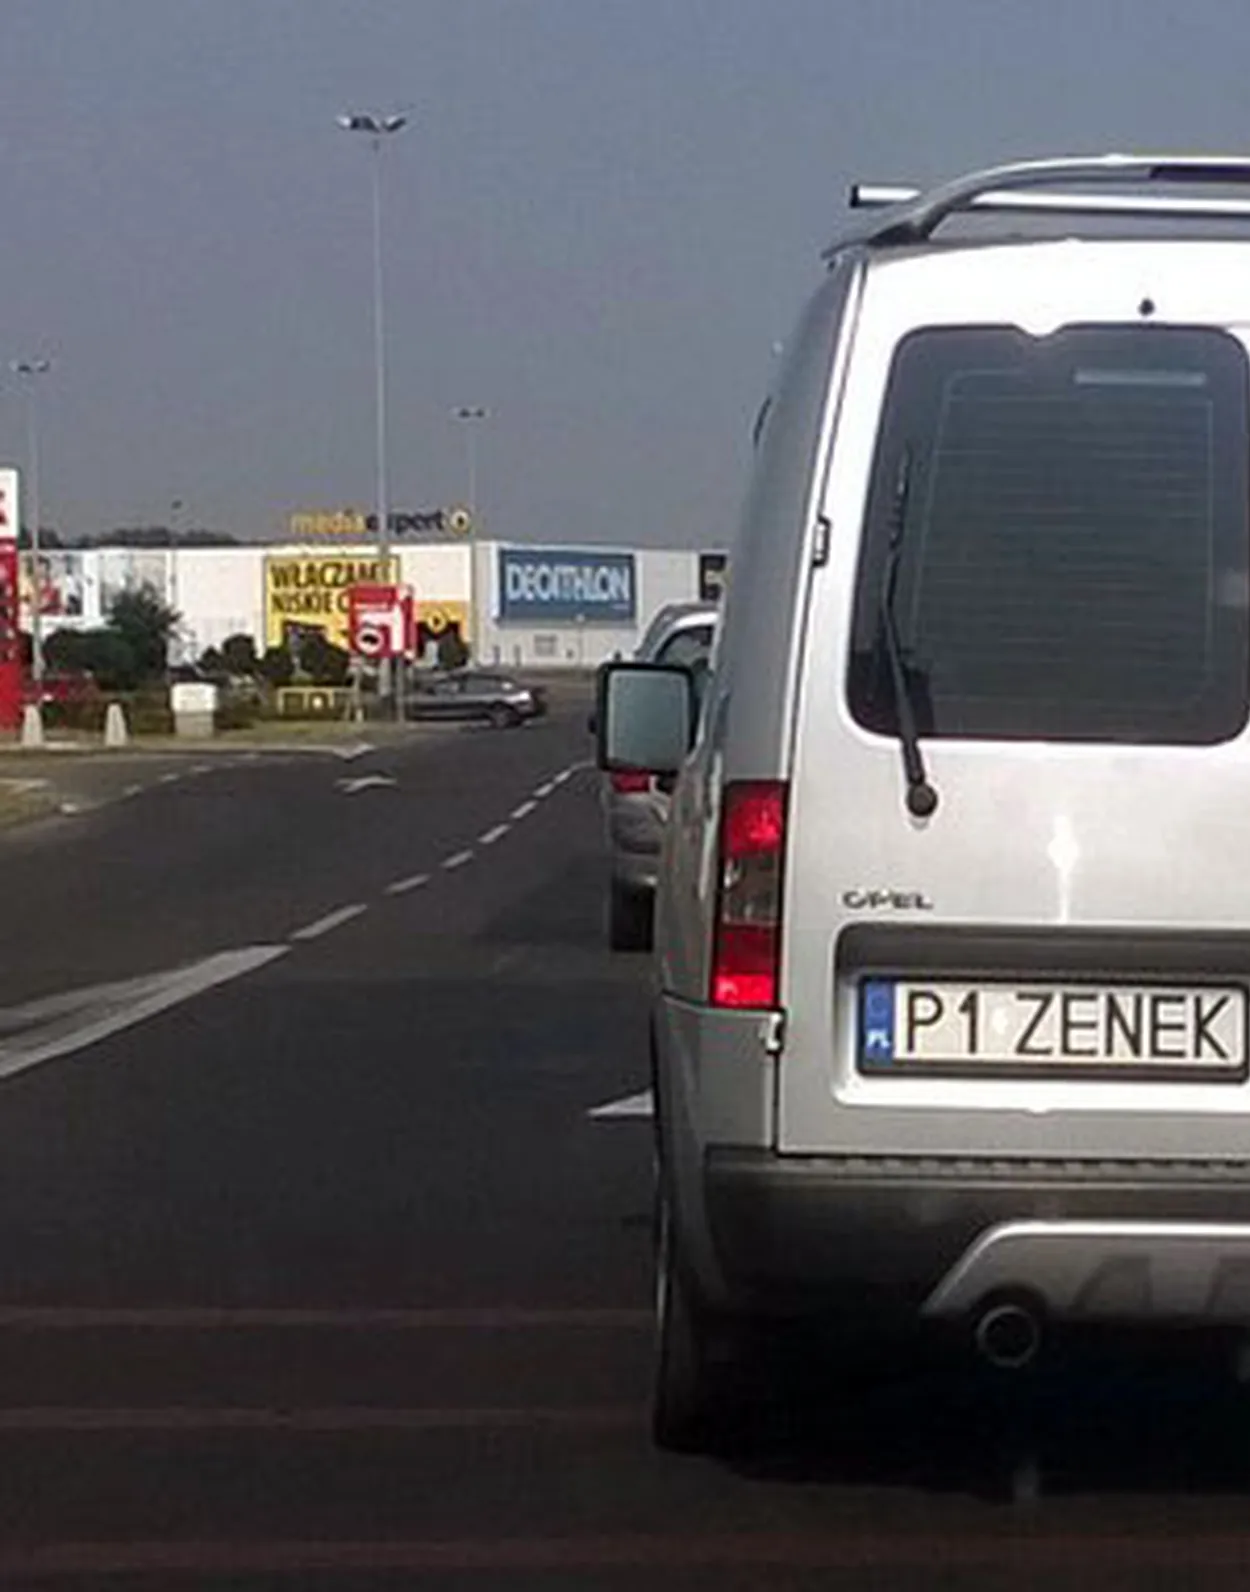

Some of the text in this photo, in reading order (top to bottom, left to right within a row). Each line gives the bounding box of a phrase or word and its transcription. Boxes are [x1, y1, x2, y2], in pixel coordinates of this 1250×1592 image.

[506, 562, 630, 601] DECATHLON
[843, 890, 934, 909] OPEL
[906, 990, 1230, 1059] P1 ZENEK
